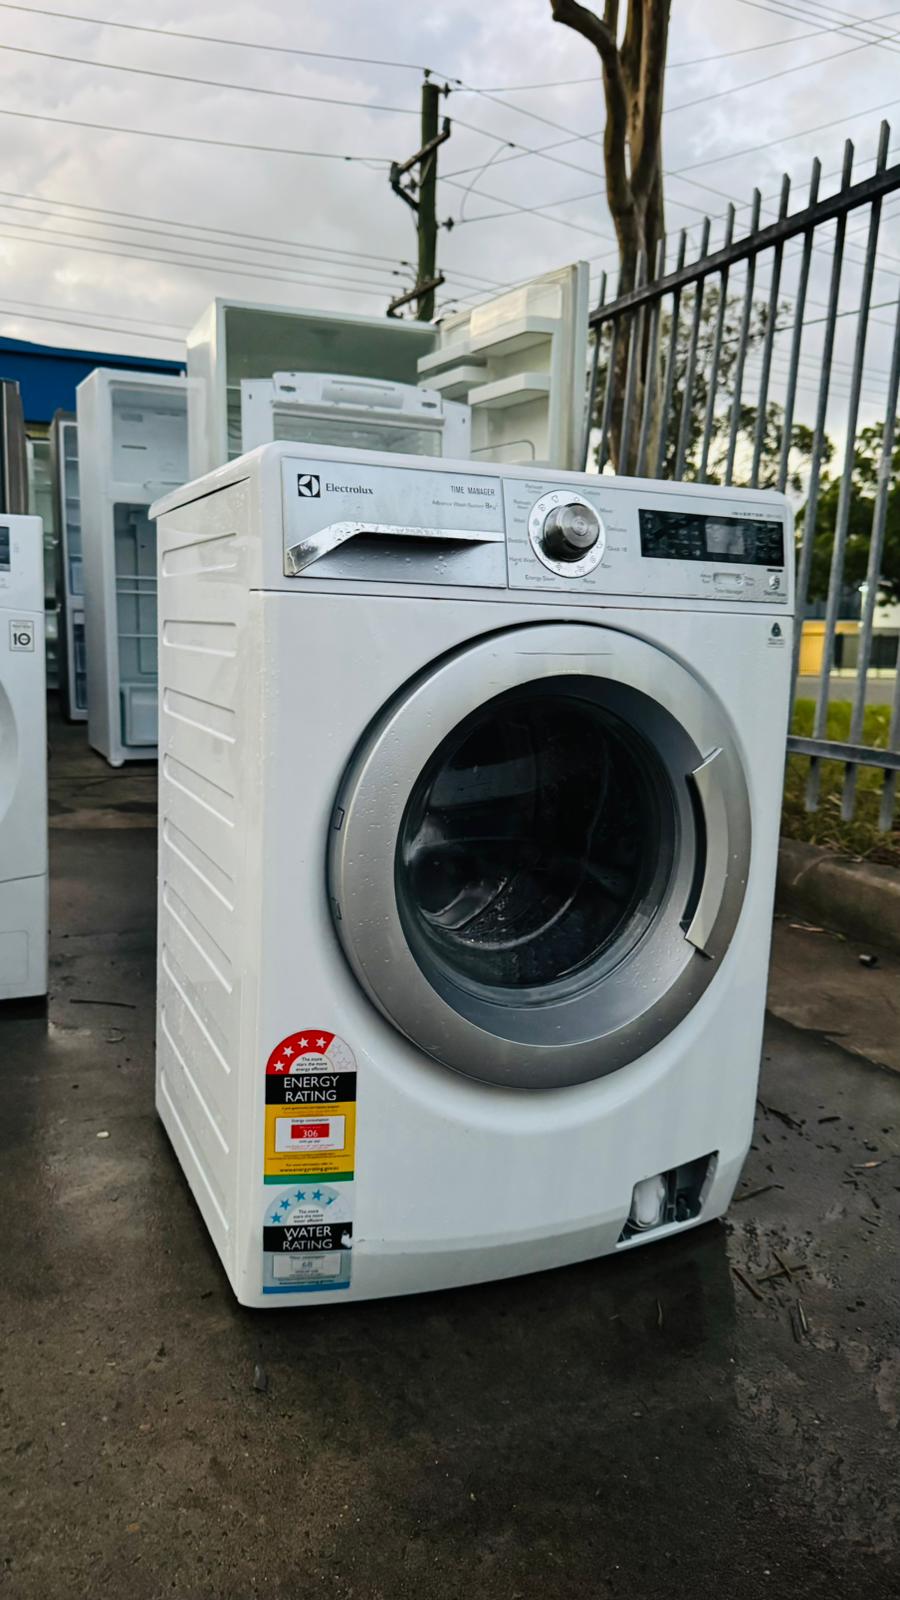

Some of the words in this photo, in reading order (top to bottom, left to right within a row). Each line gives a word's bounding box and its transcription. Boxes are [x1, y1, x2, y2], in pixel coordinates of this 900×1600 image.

[326, 483, 374, 494] Electrolux
[451, 486, 464, 494] TIME
[467, 487, 495, 496] MANAGER
[284, 1076, 340, 1088] ENERGY
[285, 1090, 337, 1102] RATING
[303, 1129, 318, 1138] 306
[284, 1226, 332, 1238] WATER
[282, 1238, 333, 1250] RATING
